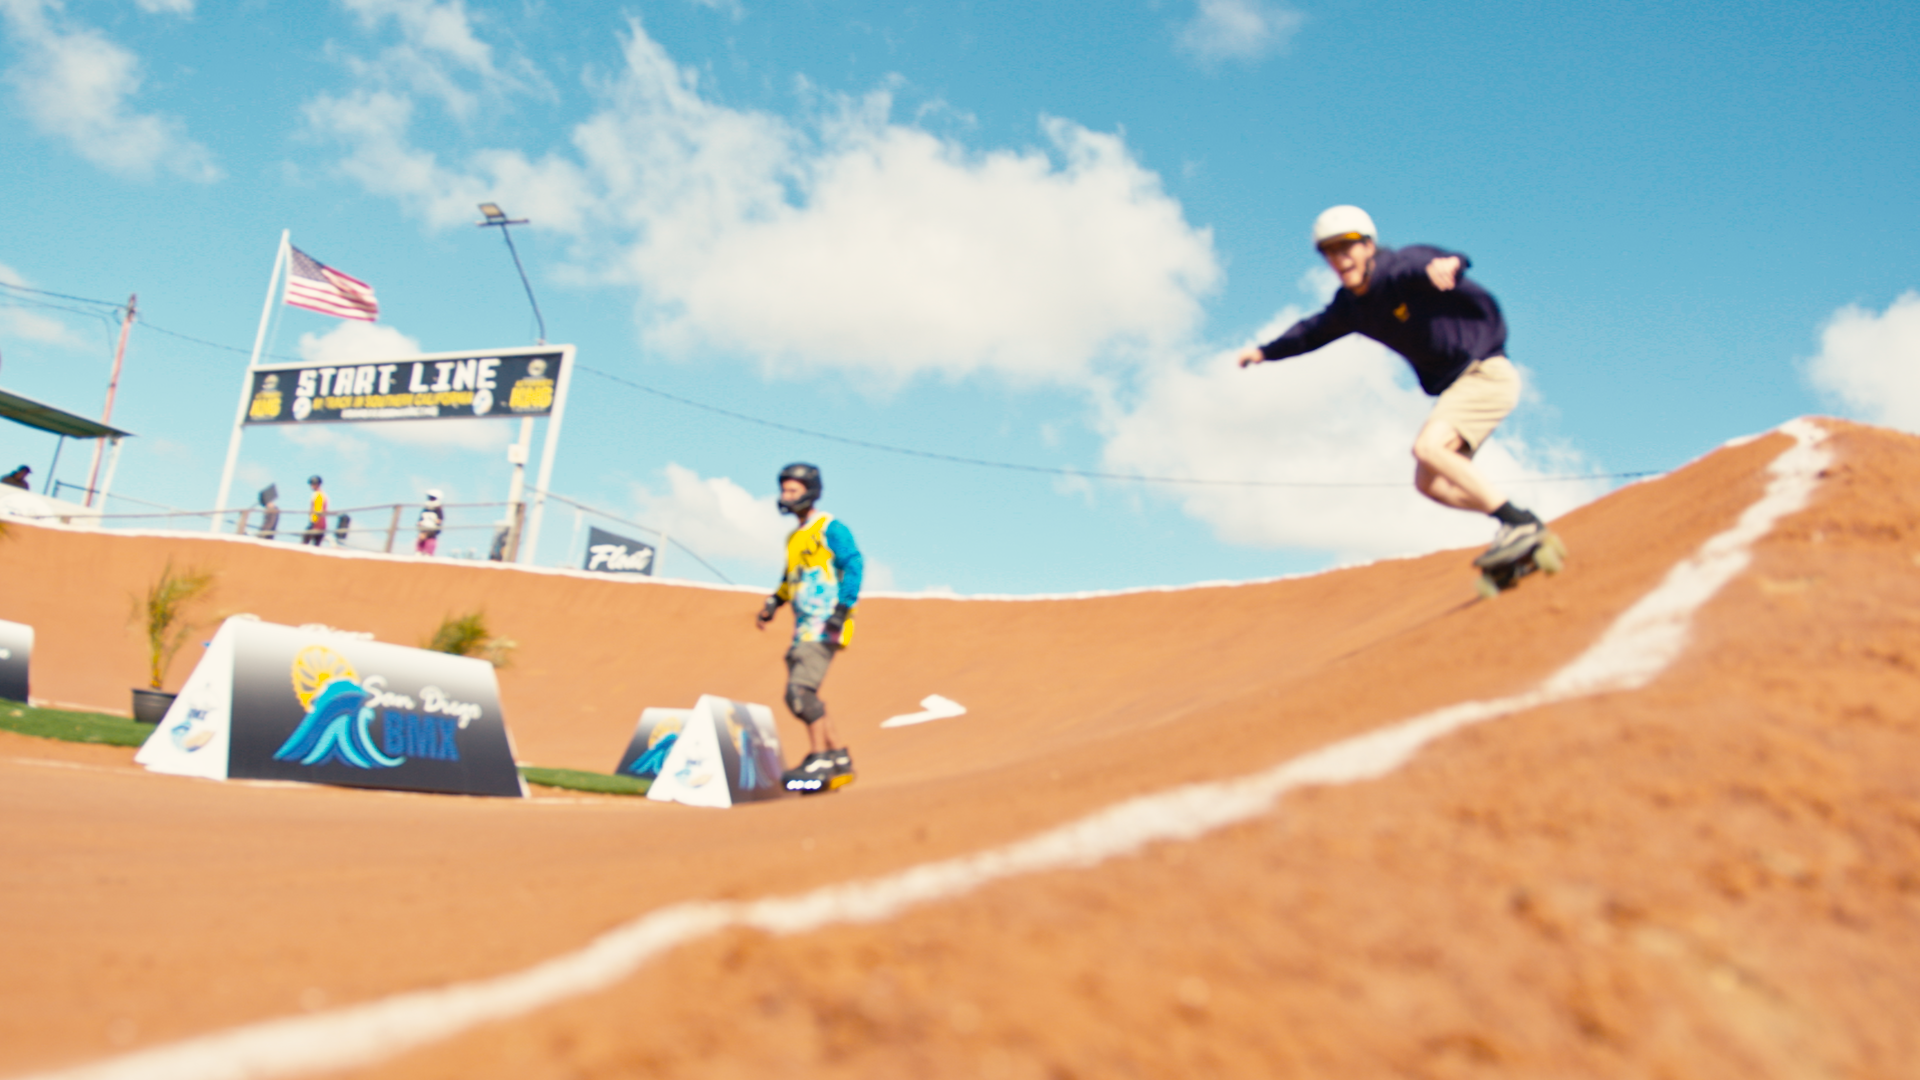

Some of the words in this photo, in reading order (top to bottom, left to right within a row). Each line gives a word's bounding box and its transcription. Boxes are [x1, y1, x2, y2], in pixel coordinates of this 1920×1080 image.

[294, 364, 398, 397] START
[408, 358, 502, 392] LINE
[588, 544, 653, 571] Float
[362, 674, 416, 711] San
[419, 685, 483, 729] Diego
[383, 709, 460, 761] BMX
